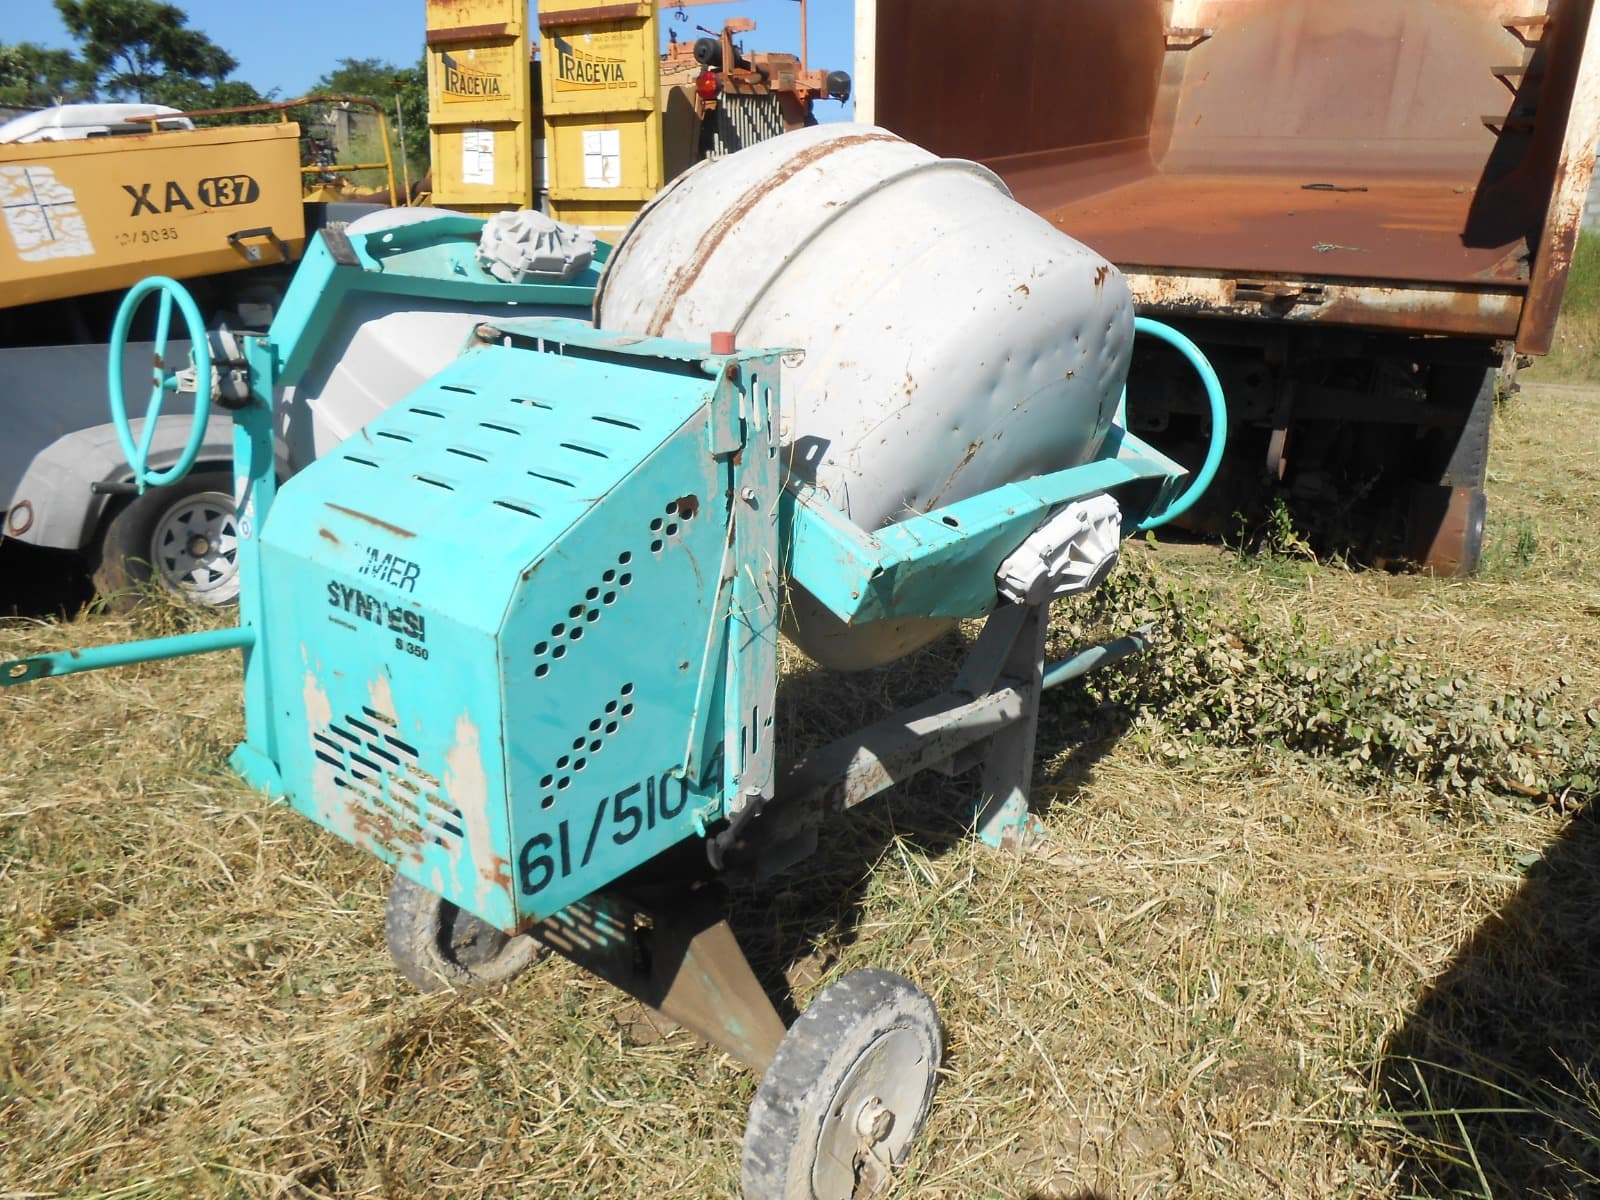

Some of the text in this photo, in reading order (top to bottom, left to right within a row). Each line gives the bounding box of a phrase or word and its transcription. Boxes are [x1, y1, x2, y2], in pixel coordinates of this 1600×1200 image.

[442, 50, 500, 95] TRACEVIA
[554, 33, 625, 82] TRACEVIA
[122, 177, 251, 217] XA 137
[327, 580, 425, 643] SYNTESI
[395, 637, 429, 661] S 350
